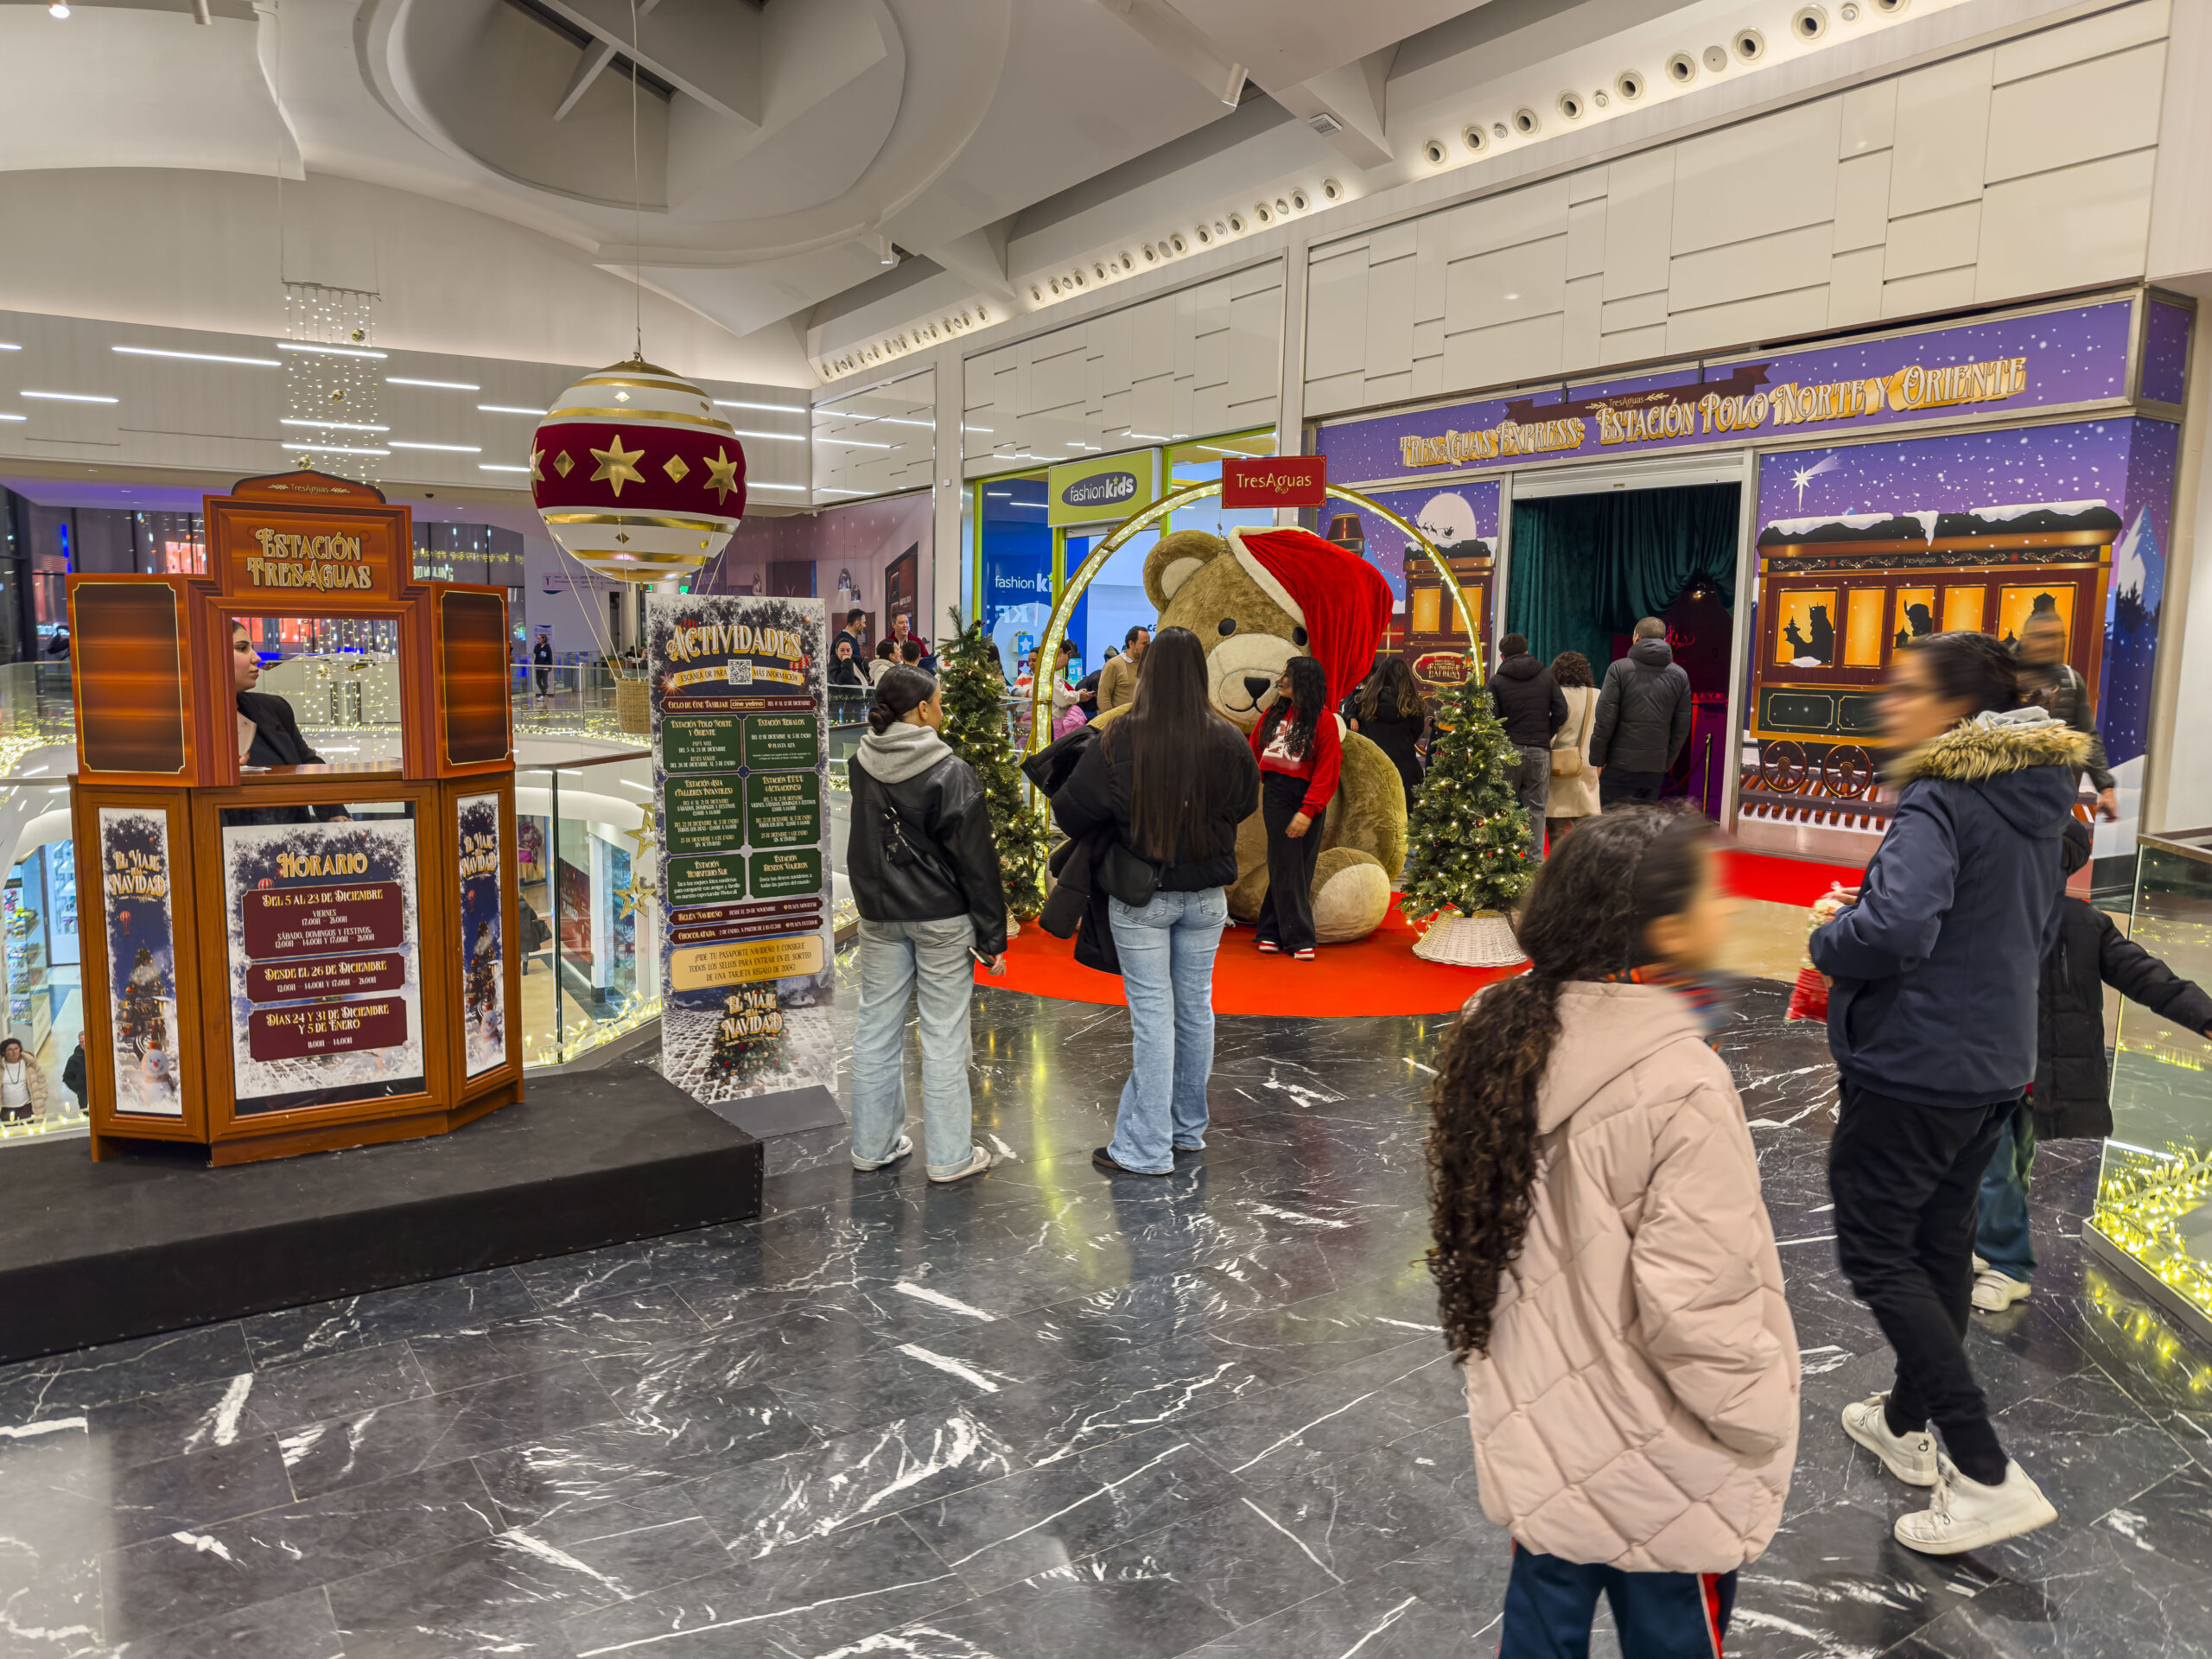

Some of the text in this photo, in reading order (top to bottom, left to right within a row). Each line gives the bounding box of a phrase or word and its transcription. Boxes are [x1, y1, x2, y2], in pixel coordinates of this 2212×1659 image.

[1609, 396, 1644, 408] TresAguas
[1400, 357, 2027, 467] TRESAGUAS EXPRESS: ESTACIÓN POLO NORTE Y ORIENTE
[290, 483, 329, 495] TresAguas
[1236, 473, 1312, 493] TresAguas
[255, 528, 360, 561] ESTACIÓN
[247, 557, 372, 592] TRESAGUAS
[995, 575, 1035, 589] fashion
[665, 625, 803, 663] ACTIVIDADES
[681, 671, 704, 683] ESCANEA
[714, 669, 728, 677] PARA
[766, 670, 798, 681] INFORMACIÓN
[276, 851, 369, 878] HORARIO
[108, 873, 166, 897] NAVIDAD
[262, 888, 384, 907] DEL 5 AL 23 DE DICIEMBRE
[312, 909, 337, 918] VIERNES
[305, 928, 336, 938] DOMINGOS
[337, 928, 342, 937] Y
[323, 937, 328, 945] Y
[677, 931, 715, 940] CHOCOLATADA
[719, 948, 748, 959] PASAPORTE
[781, 942, 805, 950] CONSIGUE
[264, 961, 387, 982] DESDE EL 26 DE DICIEMBRE
[690, 964, 707, 973] TODOS
[709, 963, 717, 971] LOS
[719, 961, 737, 969] SELLOS
[753, 957, 775, 966] ENTRAR
[791, 952, 812, 961] SORTEO
[326, 980, 331, 988] Y
[724, 990, 777, 1014] EL VIAJE
[266, 1004, 390, 1027] DÍAS 24 Y 31 DE DICIEMBRE
[298, 1020, 361, 1035] Y 5 DE ENERO
[721, 1012, 783, 1041] NAVIDAD
